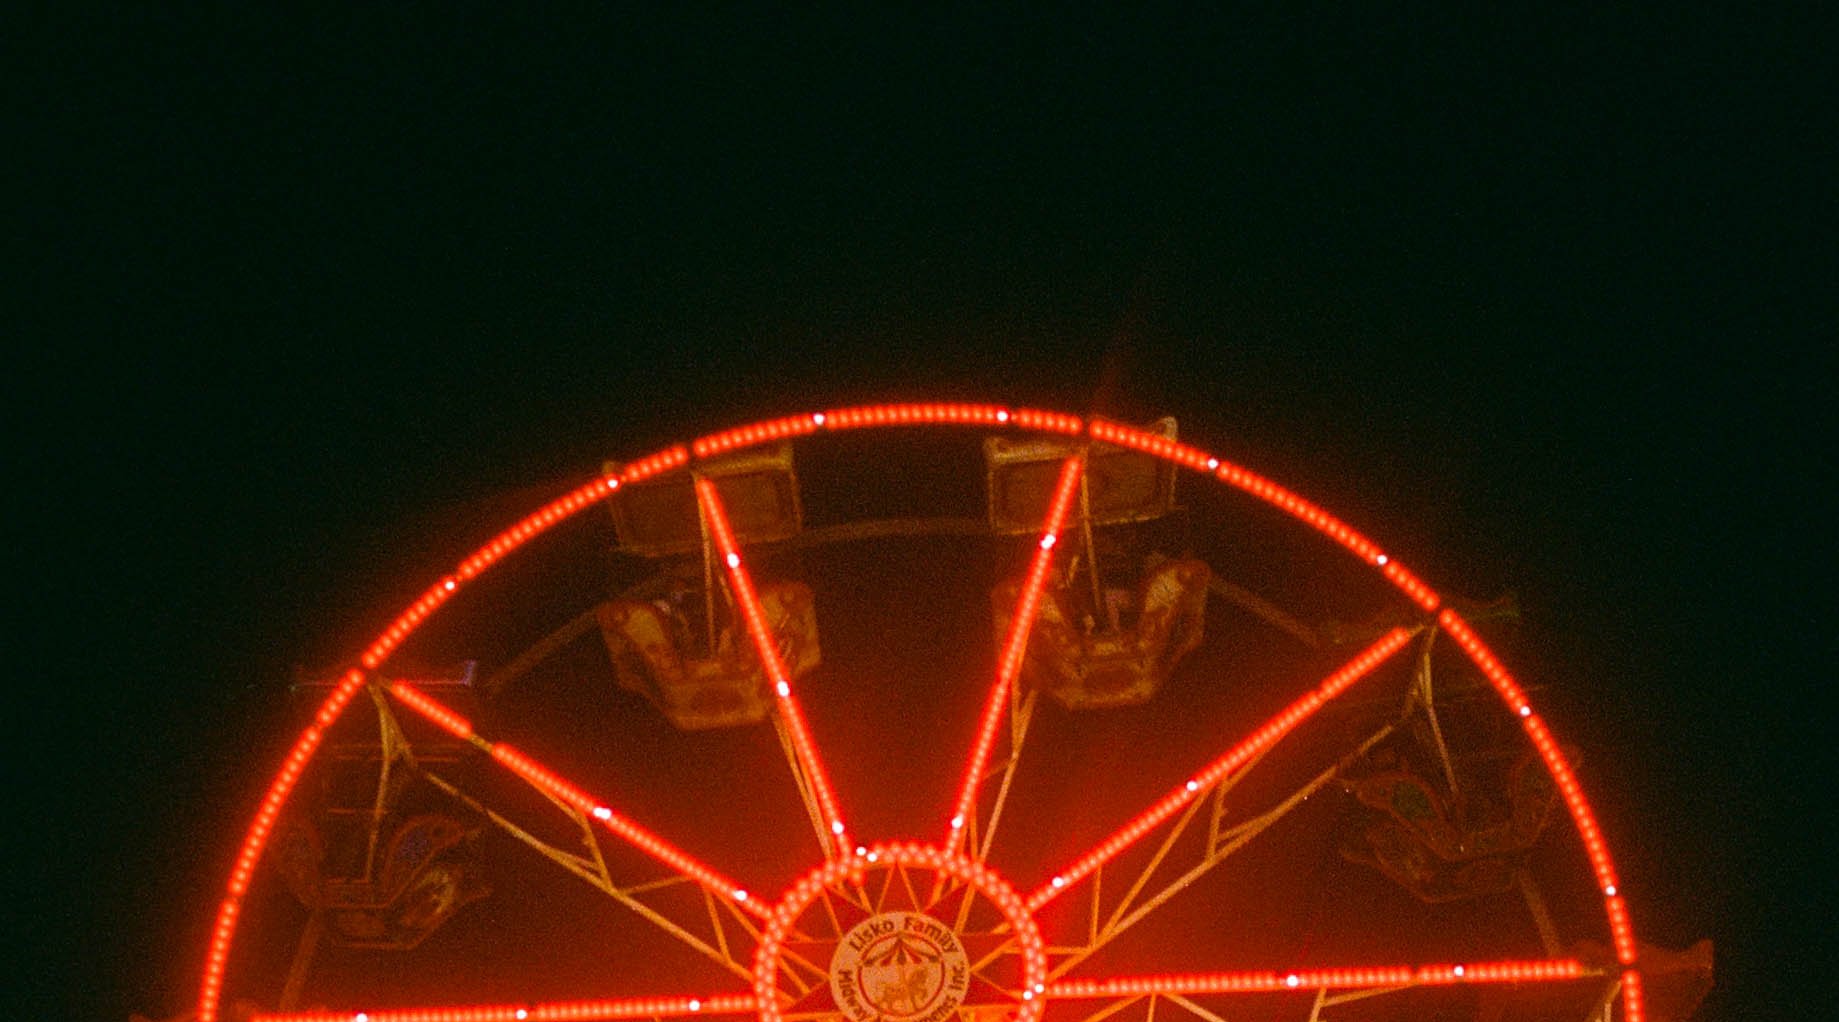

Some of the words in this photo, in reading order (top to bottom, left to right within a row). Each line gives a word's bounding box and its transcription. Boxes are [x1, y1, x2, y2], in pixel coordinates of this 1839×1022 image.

[848, 920, 895, 952] Lisko
[904, 916, 960, 954] Family
[838, 969, 871, 1022] Midway
[948, 960, 966, 991] Inc.
